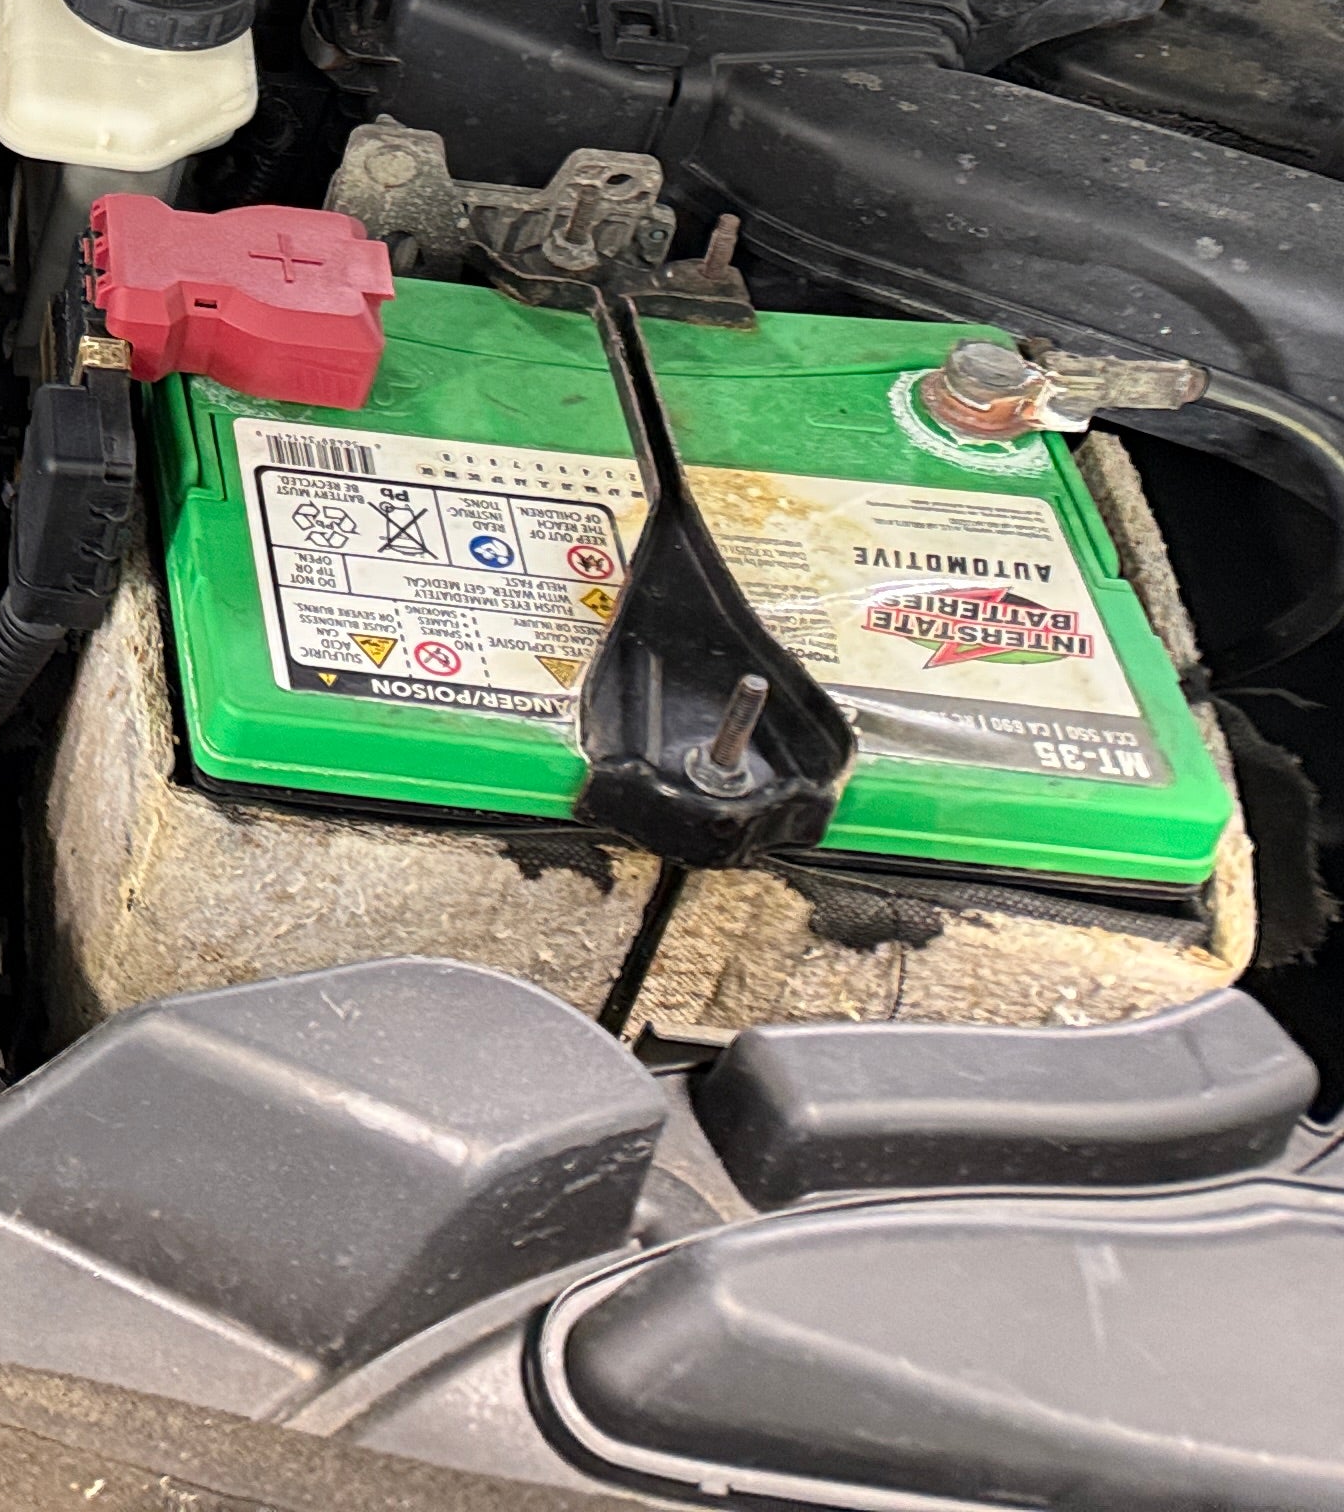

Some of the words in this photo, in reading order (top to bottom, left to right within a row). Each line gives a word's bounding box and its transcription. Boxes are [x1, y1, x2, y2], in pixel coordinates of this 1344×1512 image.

[277, 475, 340, 492] RECYCLED.
[343, 483, 359, 493] BE
[276, 485, 310, 498] MUST
[313, 489, 365, 504] BATTERY
[380, 488, 410, 502] Pb
[458, 498, 502, 511] TIONS.
[516, 507, 581, 522] CHILDREN.
[584, 514, 601, 524] OF
[473, 521, 506, 533] READ
[537, 519, 578, 533] REACH
[581, 524, 606, 536] THE
[529, 530, 546, 540] OF
[548, 532, 573, 543] OUT
[576, 535, 607, 547] KEEP
[294, 552, 332, 565] OPEN.
[853, 547, 1052, 583] AUTOMOTIVE
[295, 563, 312, 574] OR
[316, 566, 335, 577] TIP
[290, 574, 315, 586] NOT
[318, 577, 336, 588] DO
[403, 576, 460, 592] MEDICAL
[464, 584, 486, 595] GET
[537, 581, 568, 593] HELP
[414, 589, 499, 607] IMMEDIATELY
[537, 592, 572, 605] WITH
[405, 605, 457, 618] SMOKING
[502, 599, 531, 611] EYES
[536, 603, 573, 616] FLUSH
[337, 607, 376, 620] SEVERE
[379, 613, 394, 623] OR
[878, 594, 1072, 631] BATTERIES
[298, 614, 360, 630] BLINDNESS
[362, 622, 397, 634] CAUSE
[417, 616, 459, 628] FLAMES
[316, 628, 339, 637] CAN
[421, 627, 462, 639] SPARKS
[873, 610, 1087, 655] INTERSTATE
[321, 639, 351, 651] ACID
[454, 639, 474, 652] NO
[489, 638, 555, 654] EXPLOSIVE
[300, 647, 363, 664] SULFURIC
[990, 717, 1026, 735] 690
[1026, 721, 1051, 737] CA
[1066, 725, 1101, 743] 550
[1102, 730, 1139, 747] CCA
[1033, 741, 1151, 778] MT-35
